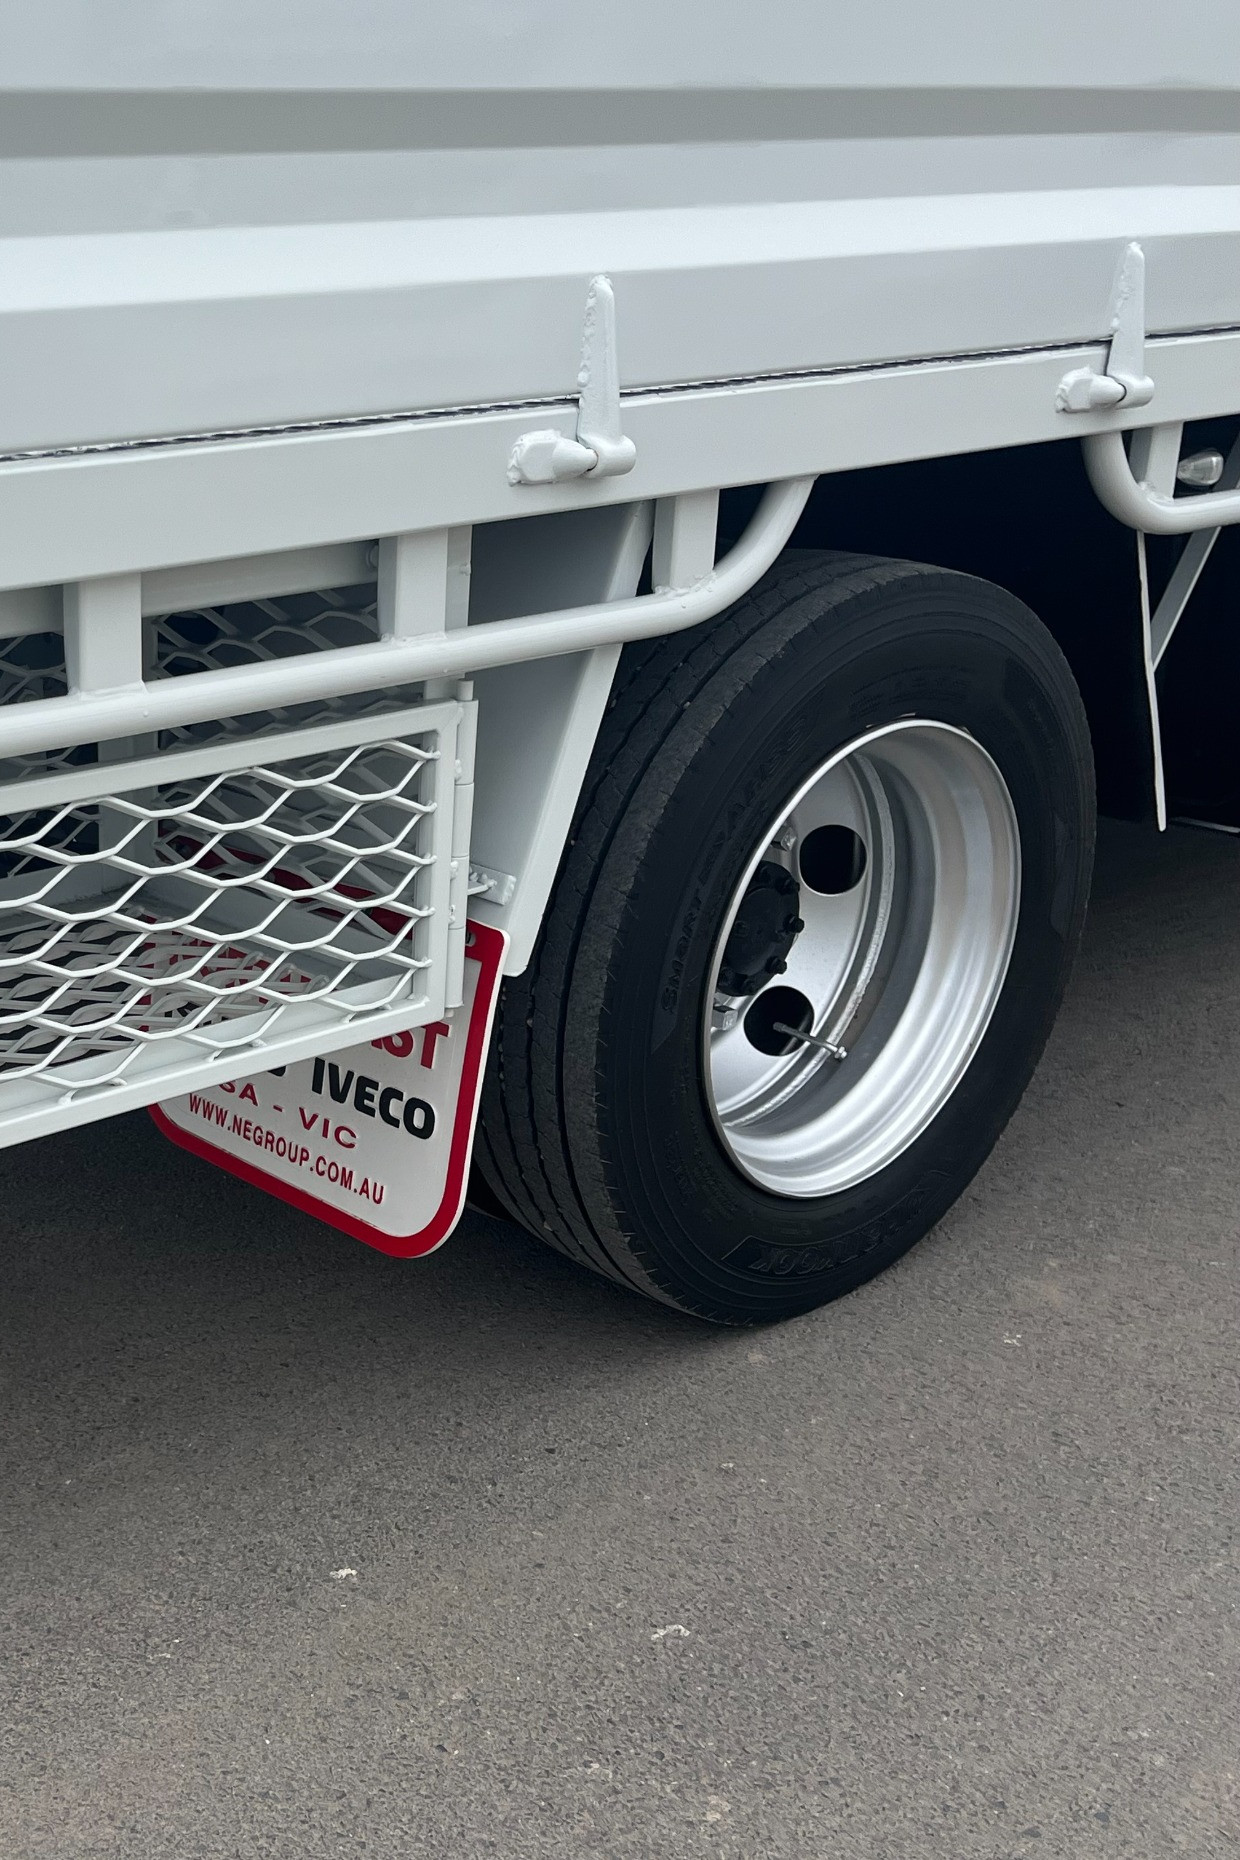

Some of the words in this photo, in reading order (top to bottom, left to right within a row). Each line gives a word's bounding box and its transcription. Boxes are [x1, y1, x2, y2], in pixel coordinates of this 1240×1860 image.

[299, 1107, 357, 1149] VIC
[312, 1057, 436, 1140] IVECO
[189, 1093, 384, 1204] WWW.NEGROUP.COM.AU
